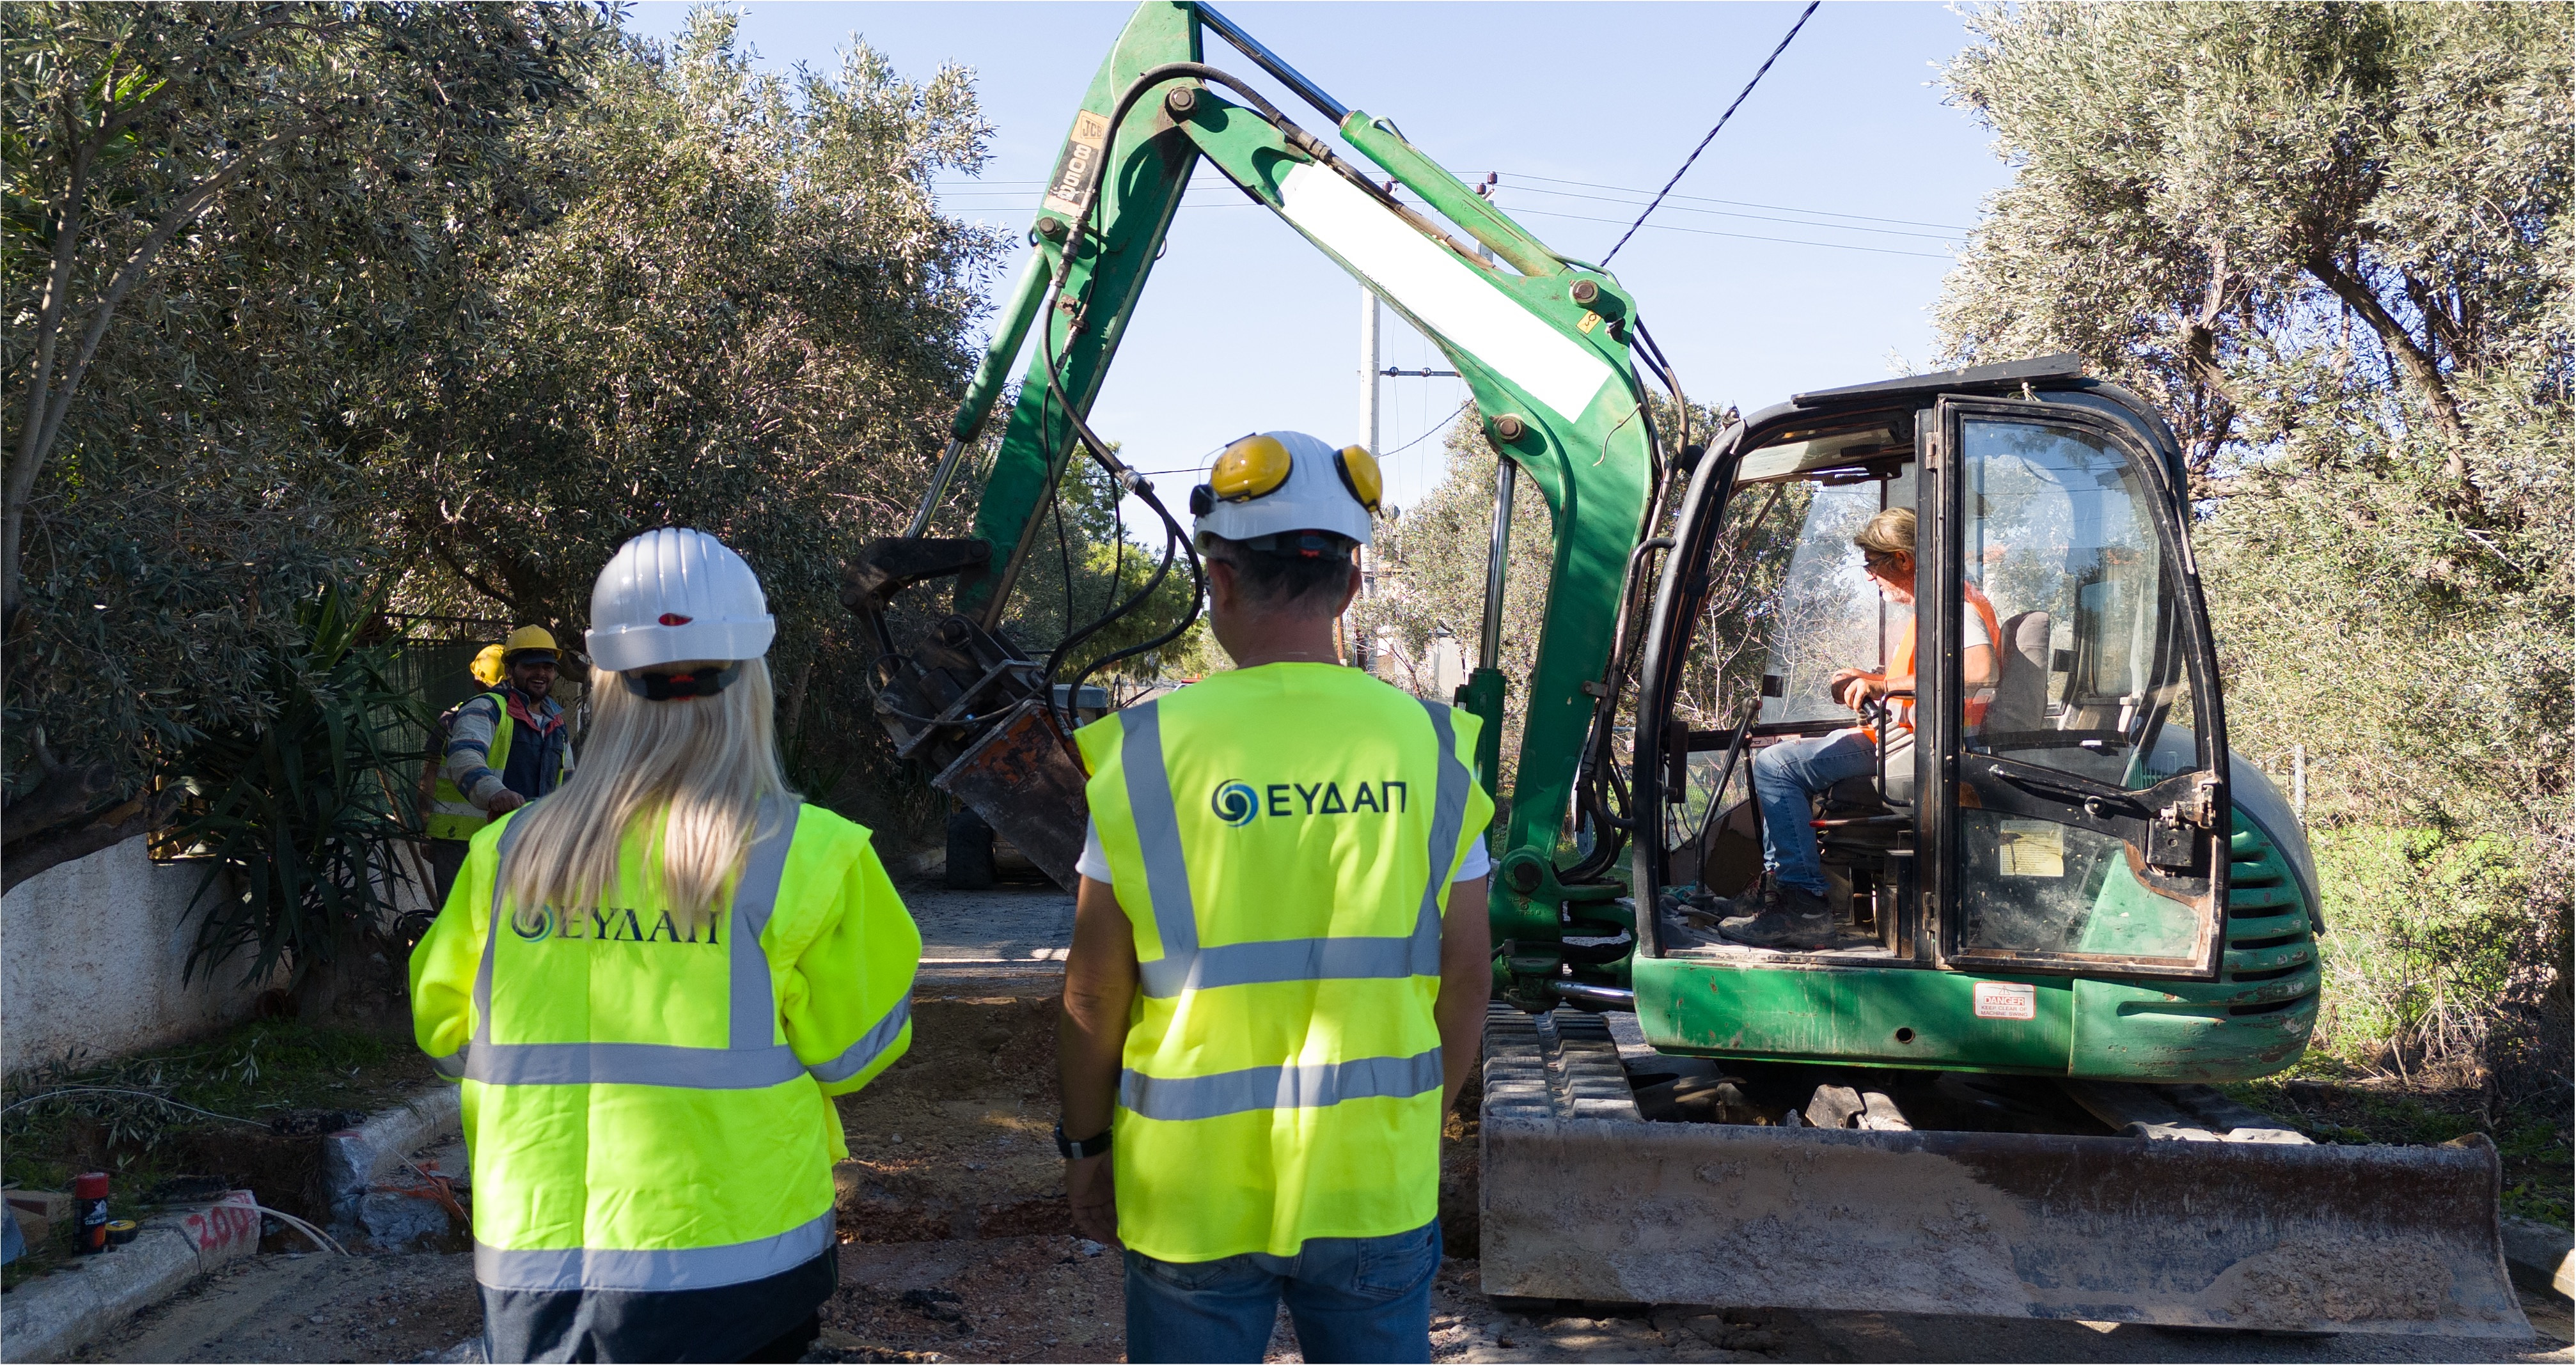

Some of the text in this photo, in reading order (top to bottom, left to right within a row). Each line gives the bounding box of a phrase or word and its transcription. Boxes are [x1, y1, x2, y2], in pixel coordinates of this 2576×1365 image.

[1082, 119, 1104, 137] JCB
[1267, 780, 1407, 817] ΕΥΔΑΠ
[1984, 996, 2025, 1006] DANGER
